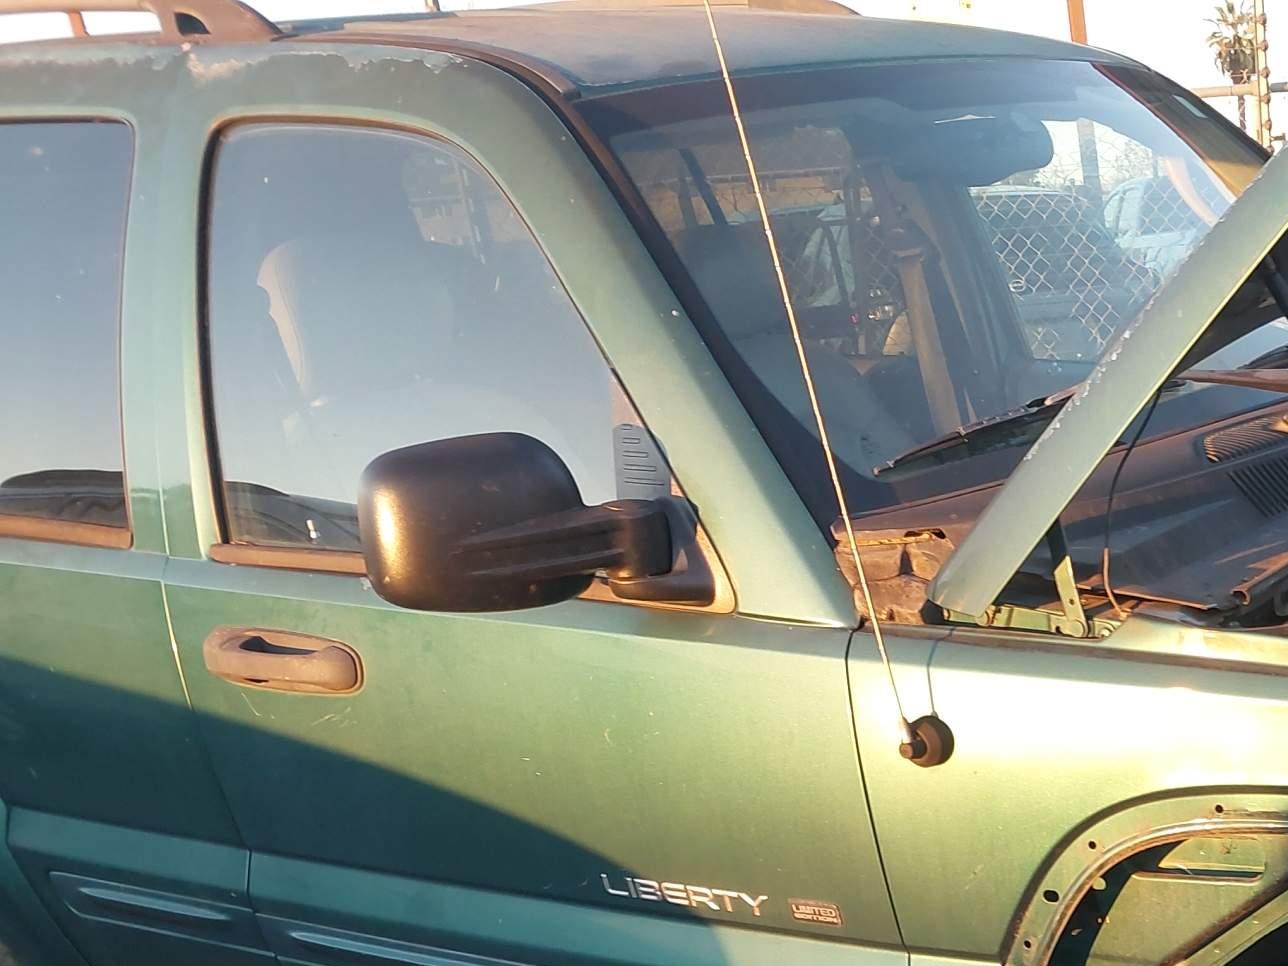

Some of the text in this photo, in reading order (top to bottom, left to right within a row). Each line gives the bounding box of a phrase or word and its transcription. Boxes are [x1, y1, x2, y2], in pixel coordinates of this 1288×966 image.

[600, 873, 768, 917] LIBERTY
[791, 903, 837, 917] LIMITED
[793, 912, 839, 924] EDITION
